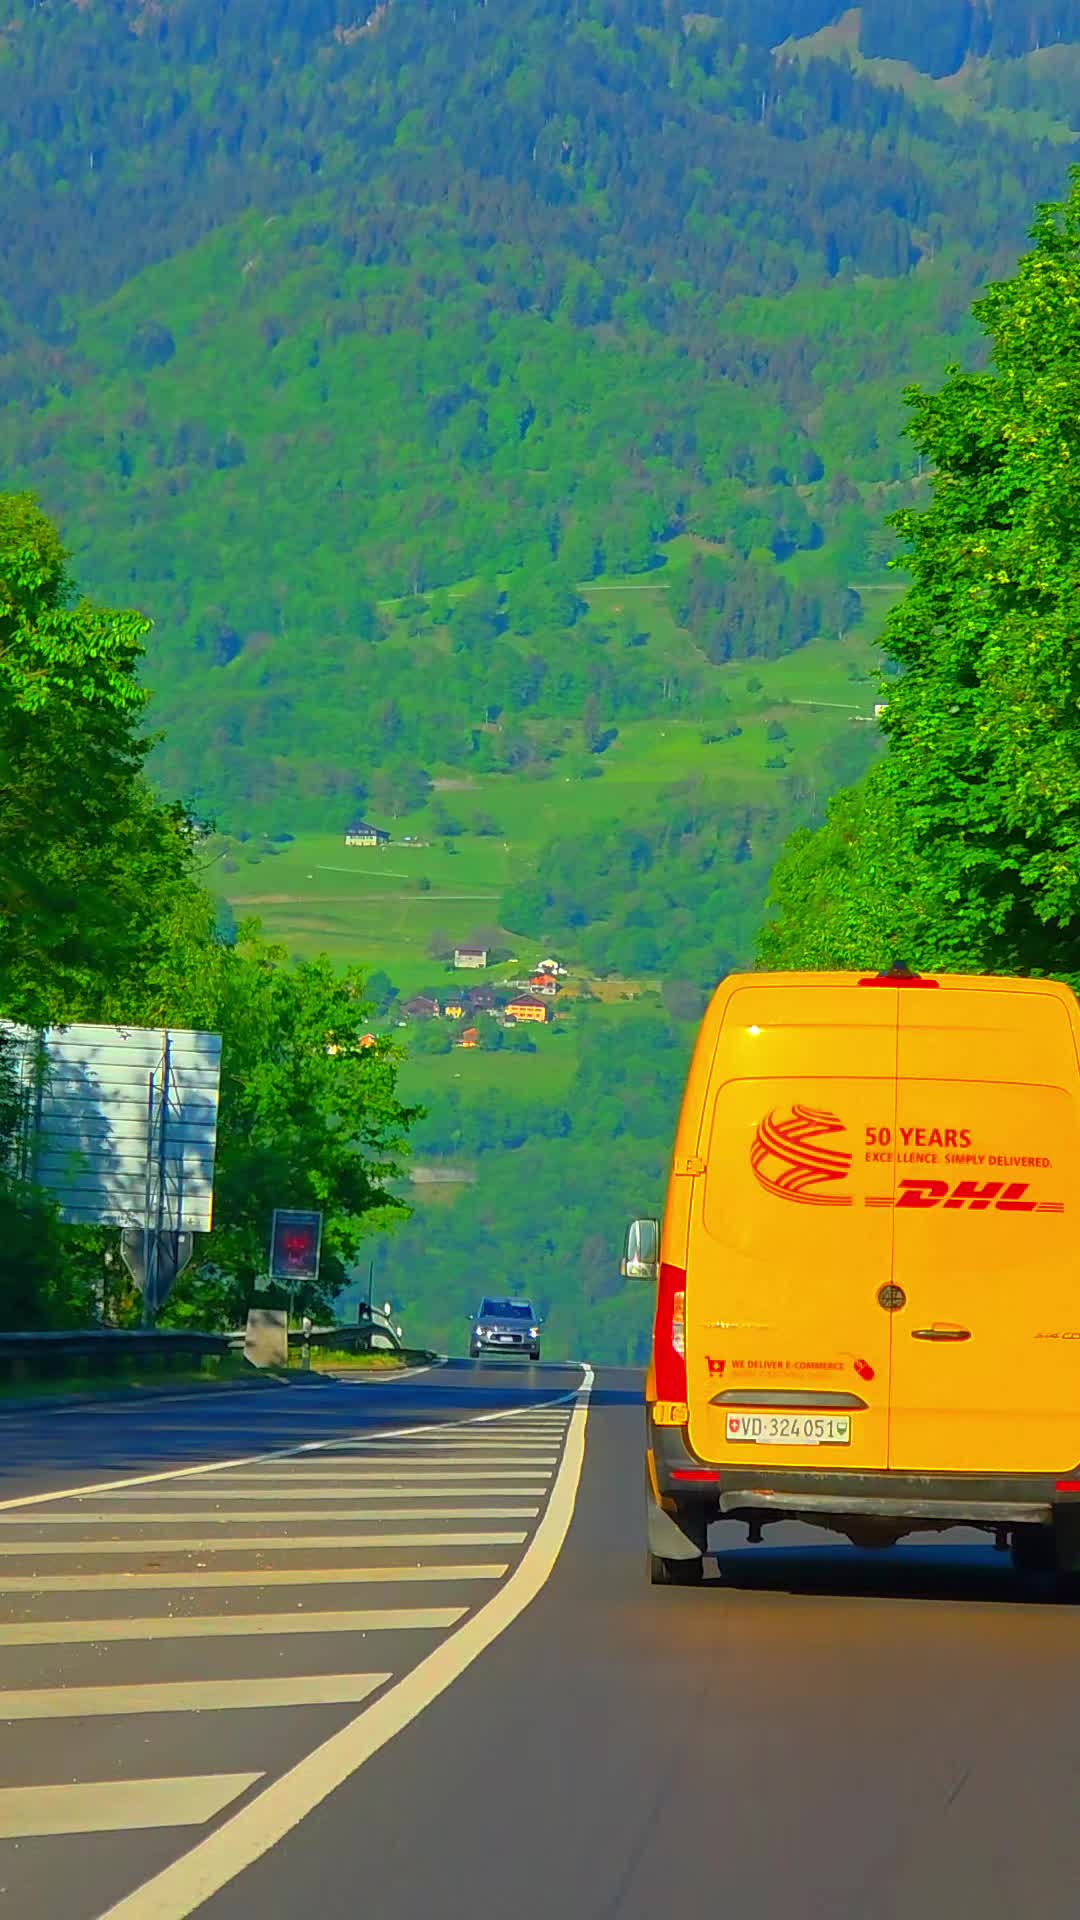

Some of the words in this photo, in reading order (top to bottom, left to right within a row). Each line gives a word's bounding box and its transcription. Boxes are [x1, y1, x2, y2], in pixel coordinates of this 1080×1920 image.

[865, 1127, 891, 1147] 50
[900, 1128, 971, 1148] YEARS
[944, 1154, 985, 1165] SIMPLY
[988, 1155, 1053, 1168] DELIVERED.
[895, 1179, 1038, 1211] DHL
[731, 1360, 745, 1369] WE
[747, 1360, 783, 1369] DELIVER
[785, 1361, 844, 1370] E-COMMERCE
